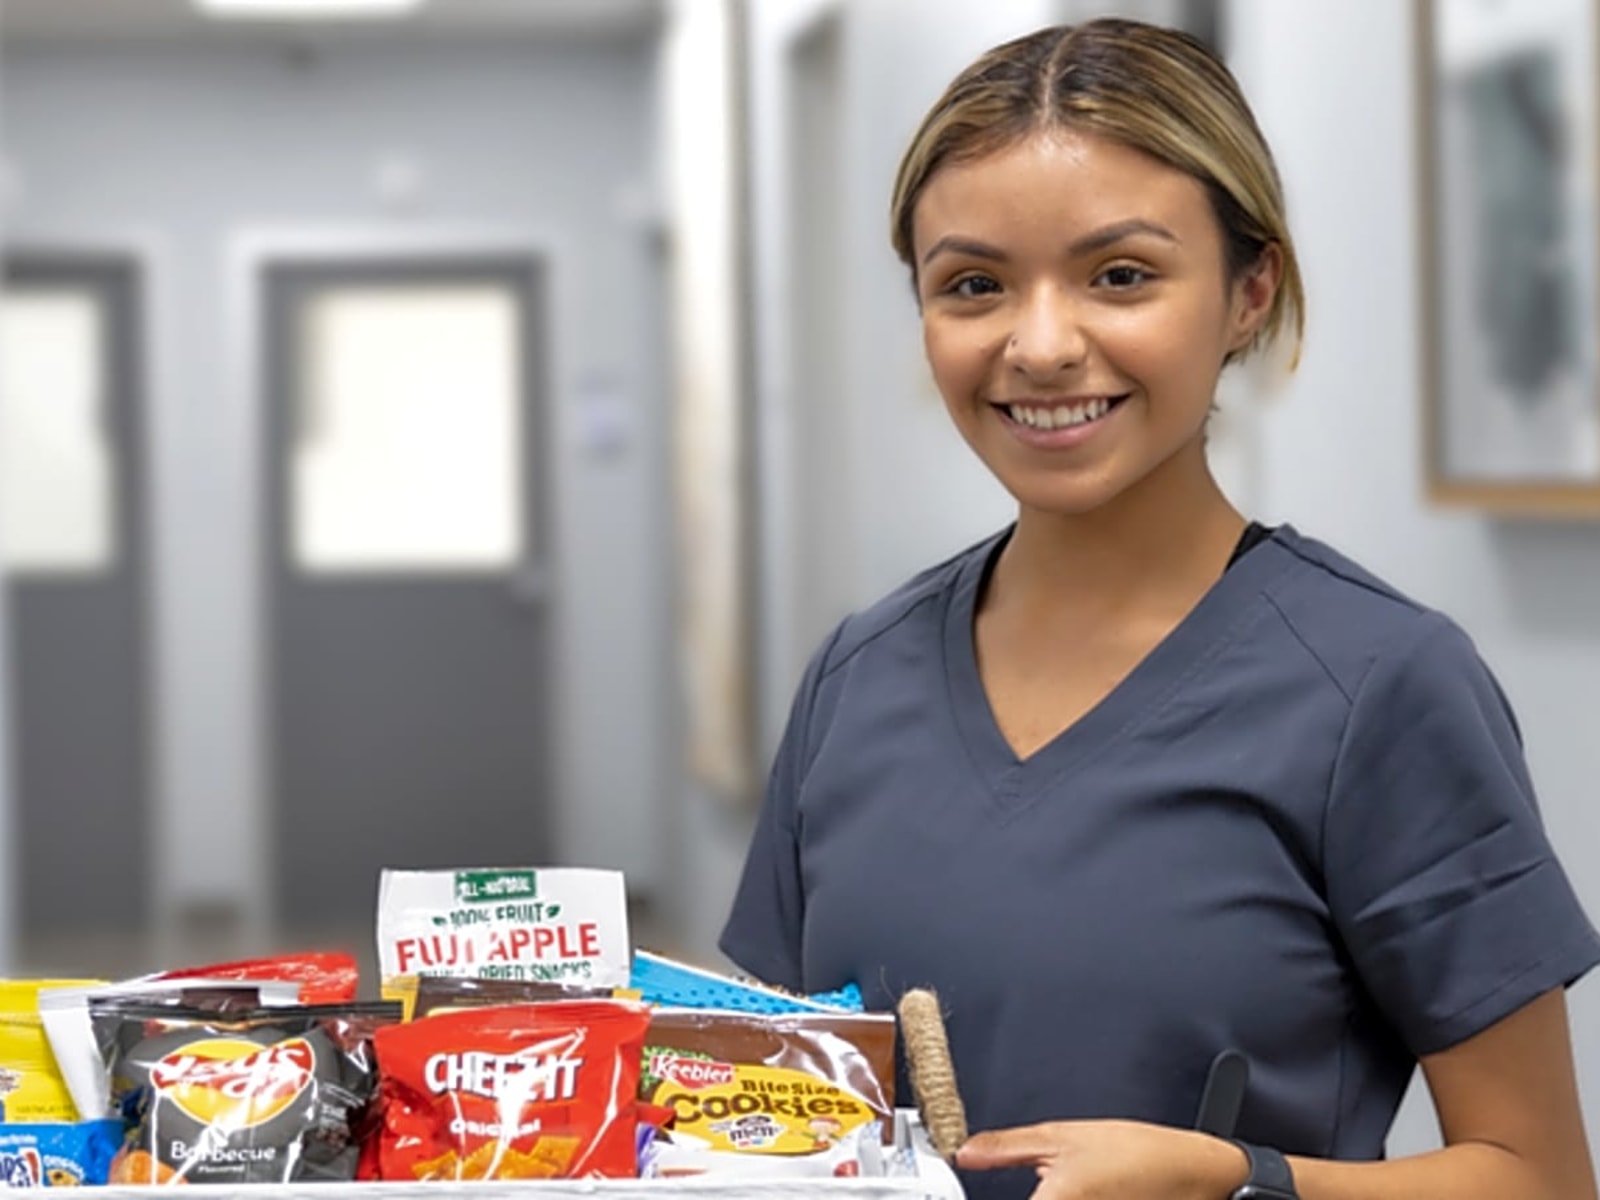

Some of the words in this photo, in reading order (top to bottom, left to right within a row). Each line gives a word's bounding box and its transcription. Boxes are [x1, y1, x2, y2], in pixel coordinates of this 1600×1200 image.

[496, 903, 544, 923] FRUIT
[396, 934, 475, 973] FUJI
[488, 923, 600, 961] APPLE
[530, 960, 591, 981] SNACKS
[424, 1051, 583, 1101] CHEEZIT
[653, 1057, 733, 1084] Keebler
[741, 1080, 788, 1095] Bite
[664, 1093, 861, 1124] Cookies
[450, 1117, 542, 1137] ORIGAL
[171, 1140, 276, 1162] Barbecue
